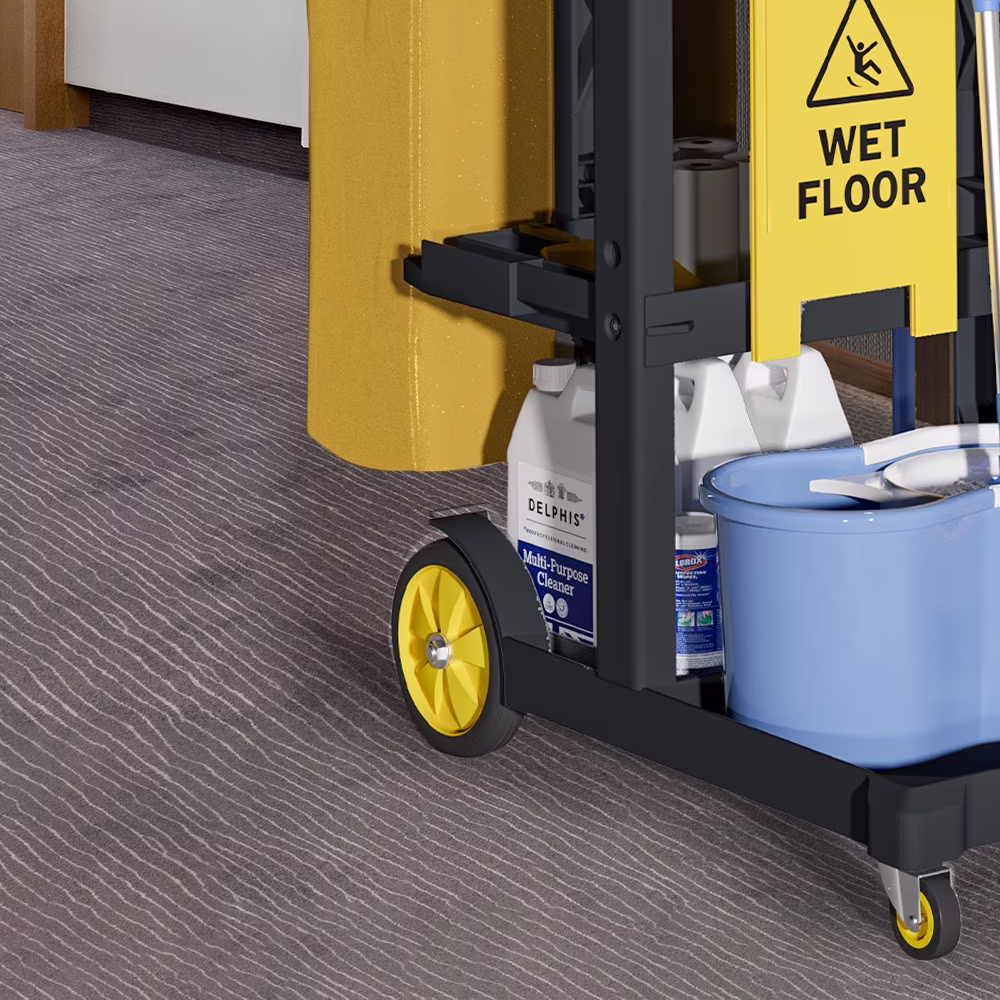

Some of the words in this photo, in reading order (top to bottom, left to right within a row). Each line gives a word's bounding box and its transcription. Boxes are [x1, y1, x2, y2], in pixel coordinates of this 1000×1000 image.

[818, 119, 906, 166] WET
[798, 166, 926, 220] FLOOR
[529, 497, 580, 527] DELPHIS
[522, 548, 589, 585] Multi-Purpose
[537, 571, 575, 596] Cleaner
